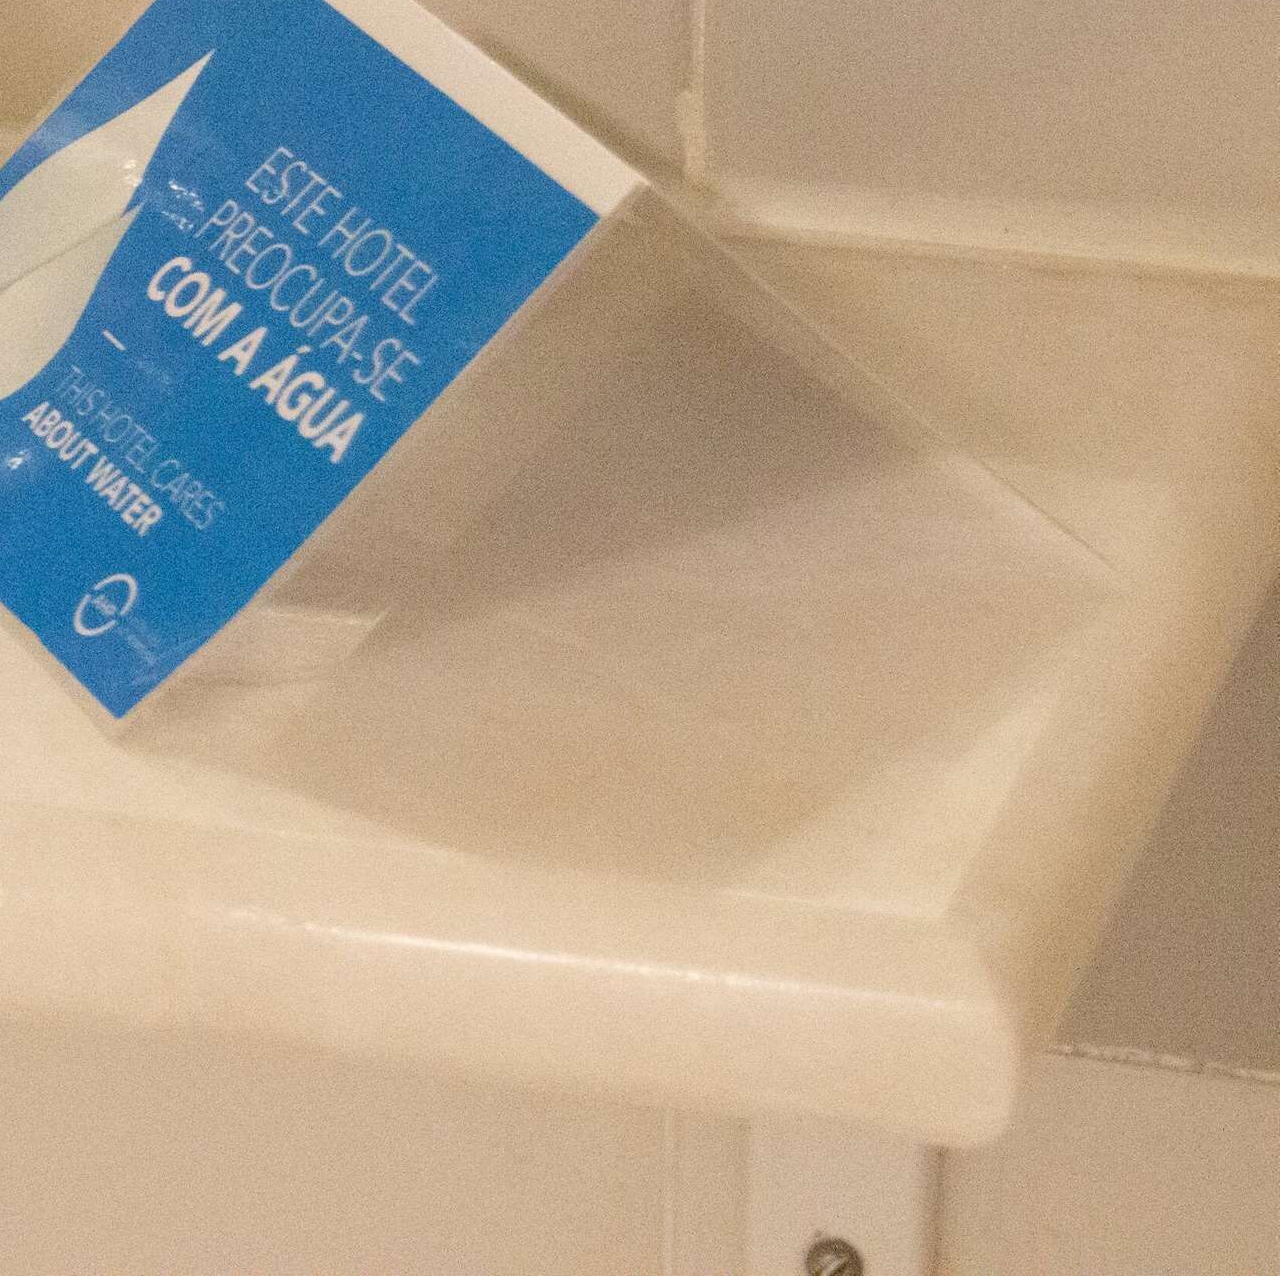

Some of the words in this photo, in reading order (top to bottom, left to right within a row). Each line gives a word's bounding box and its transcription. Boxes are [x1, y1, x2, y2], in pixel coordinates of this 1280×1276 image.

[194, 199, 423, 402] PREOCUPA-SE
[245, 146, 344, 235] ESTE
[318, 207, 439, 325] HOTEL
[56, 364, 105, 416] THIS
[89, 402, 159, 474] HOTEL
[150, 460, 226, 530] CARES
[147, 256, 242, 347] COM
[218, 326, 269, 377] A
[249, 345, 366, 464] ÁGUA
[22, 401, 99, 470] ABOUT
[85, 456, 163, 538] WATER
